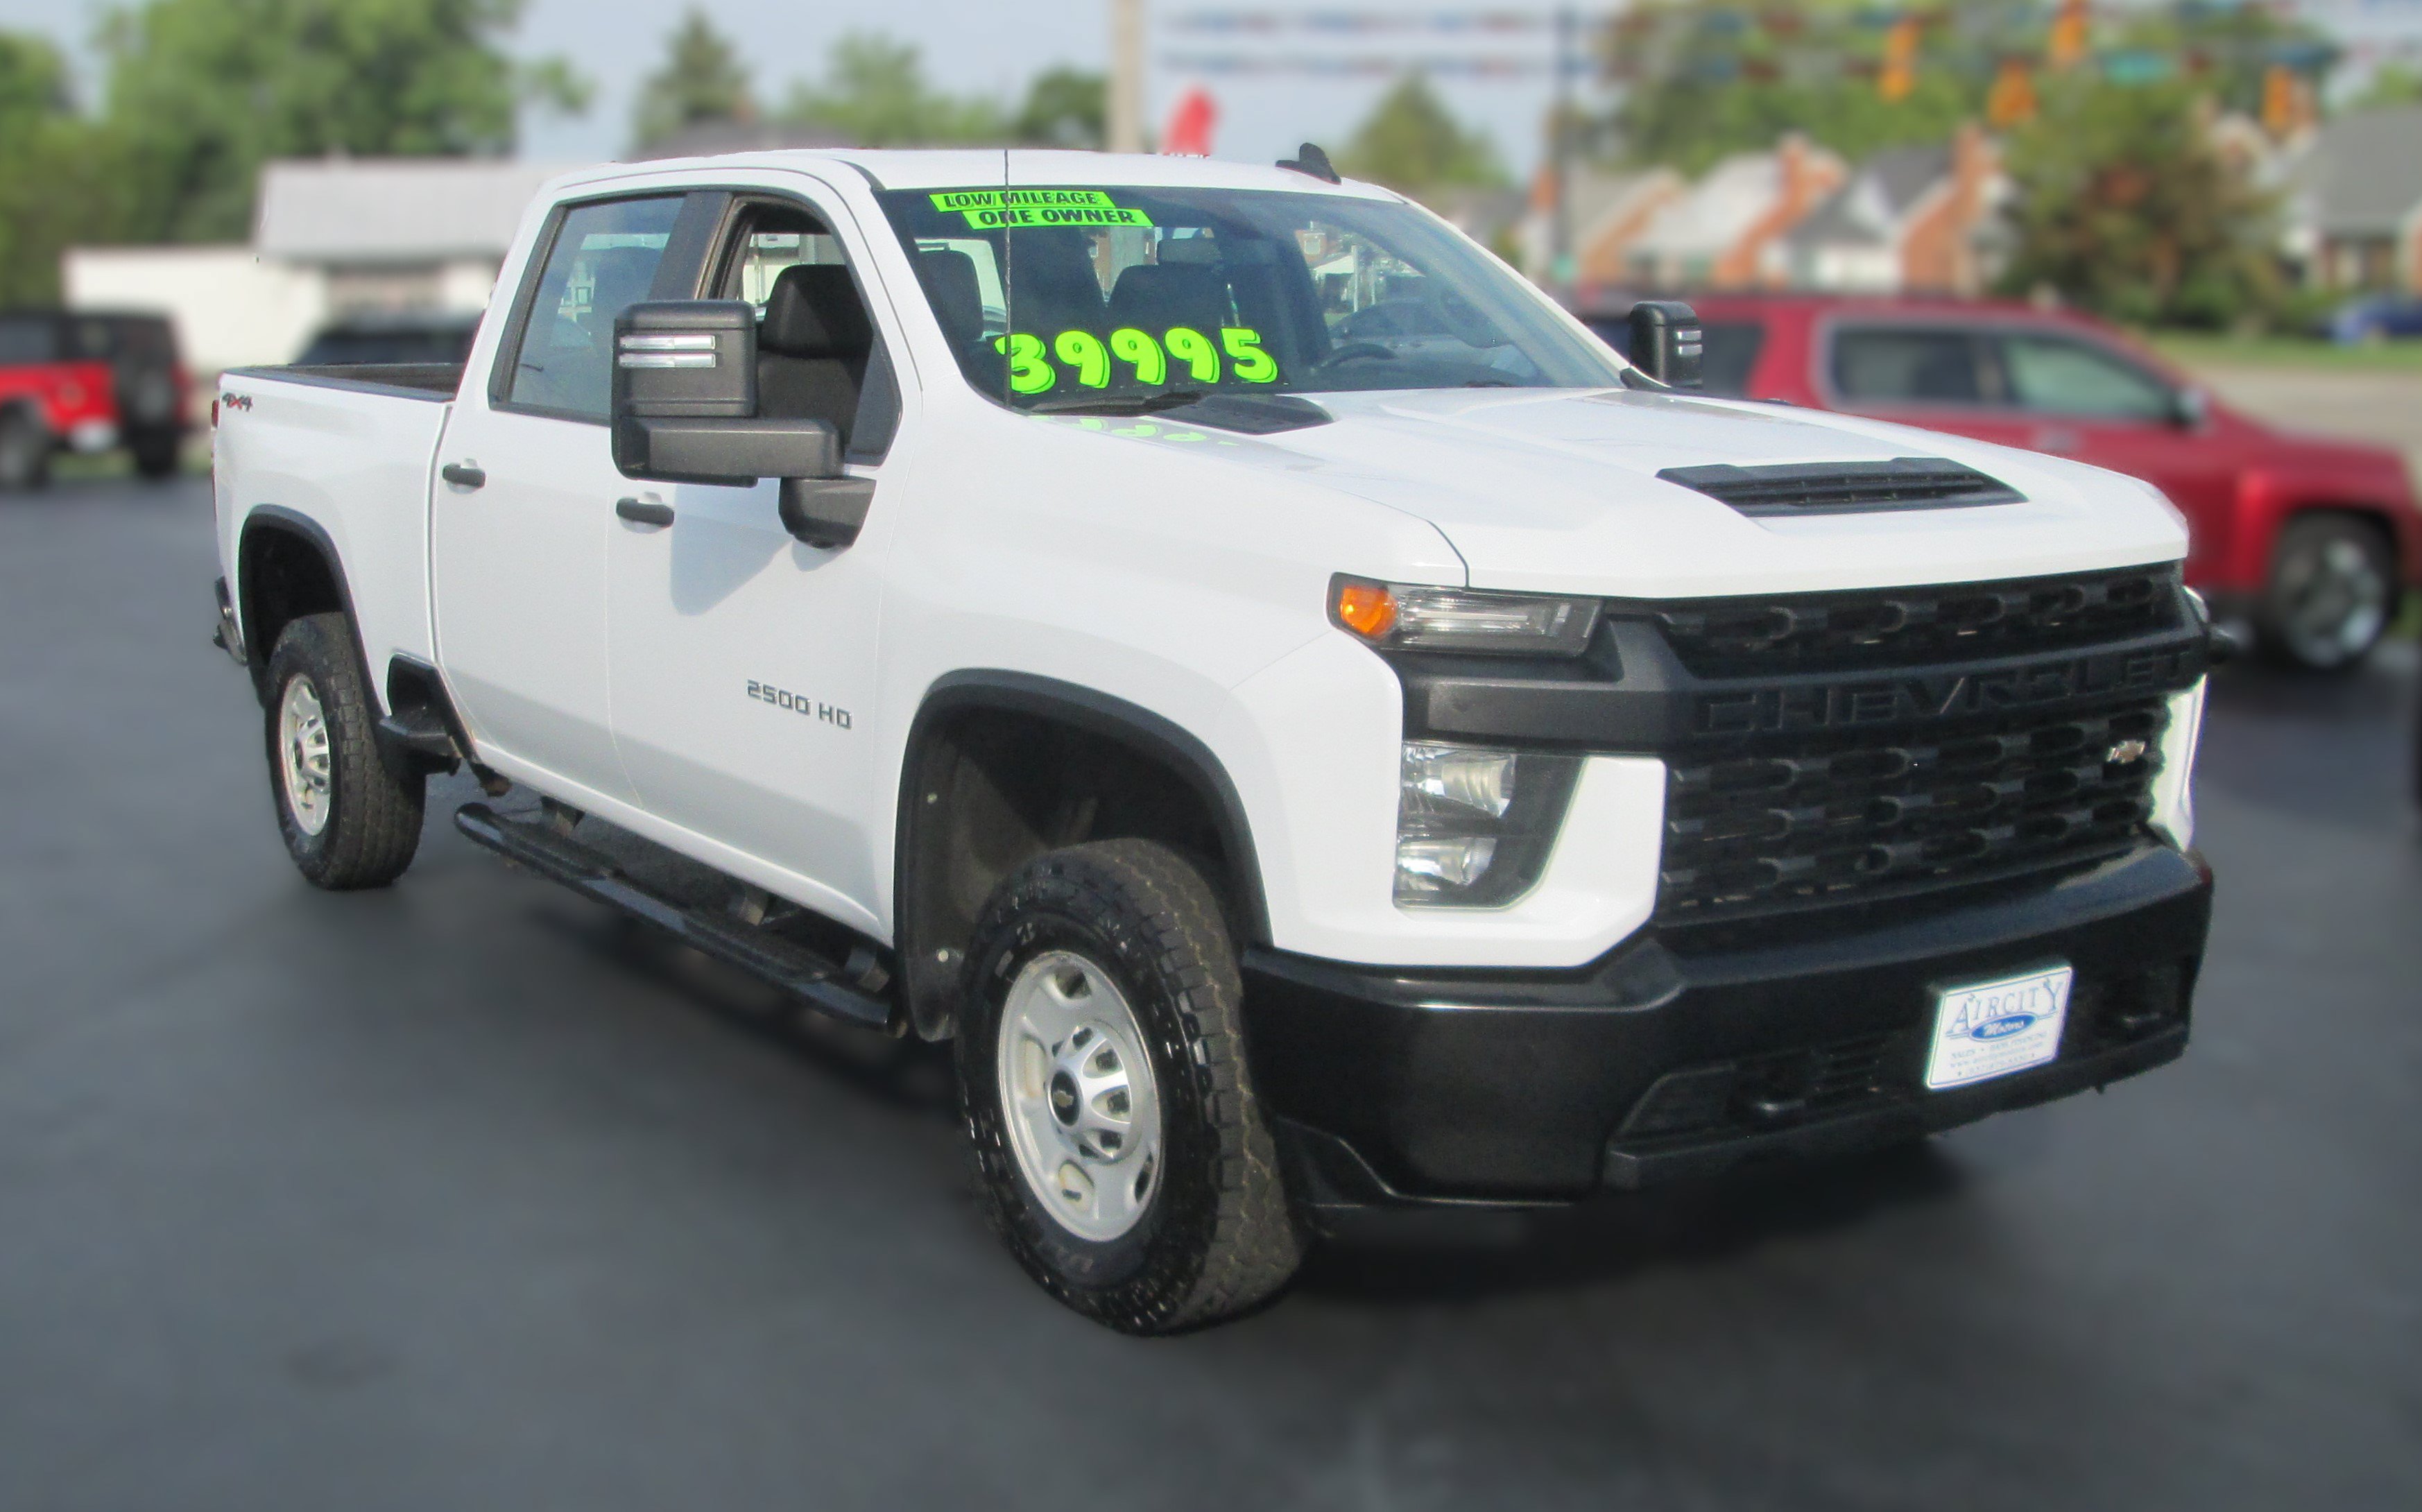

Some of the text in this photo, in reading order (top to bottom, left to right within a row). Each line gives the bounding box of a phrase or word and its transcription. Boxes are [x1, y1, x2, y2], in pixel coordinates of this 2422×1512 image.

[944, 191, 1098, 207] LOW MILEAGE
[979, 209, 1137, 225] ONE OWNER
[995, 327, 1278, 395] 39995
[747, 678, 852, 729] 2500 HD
